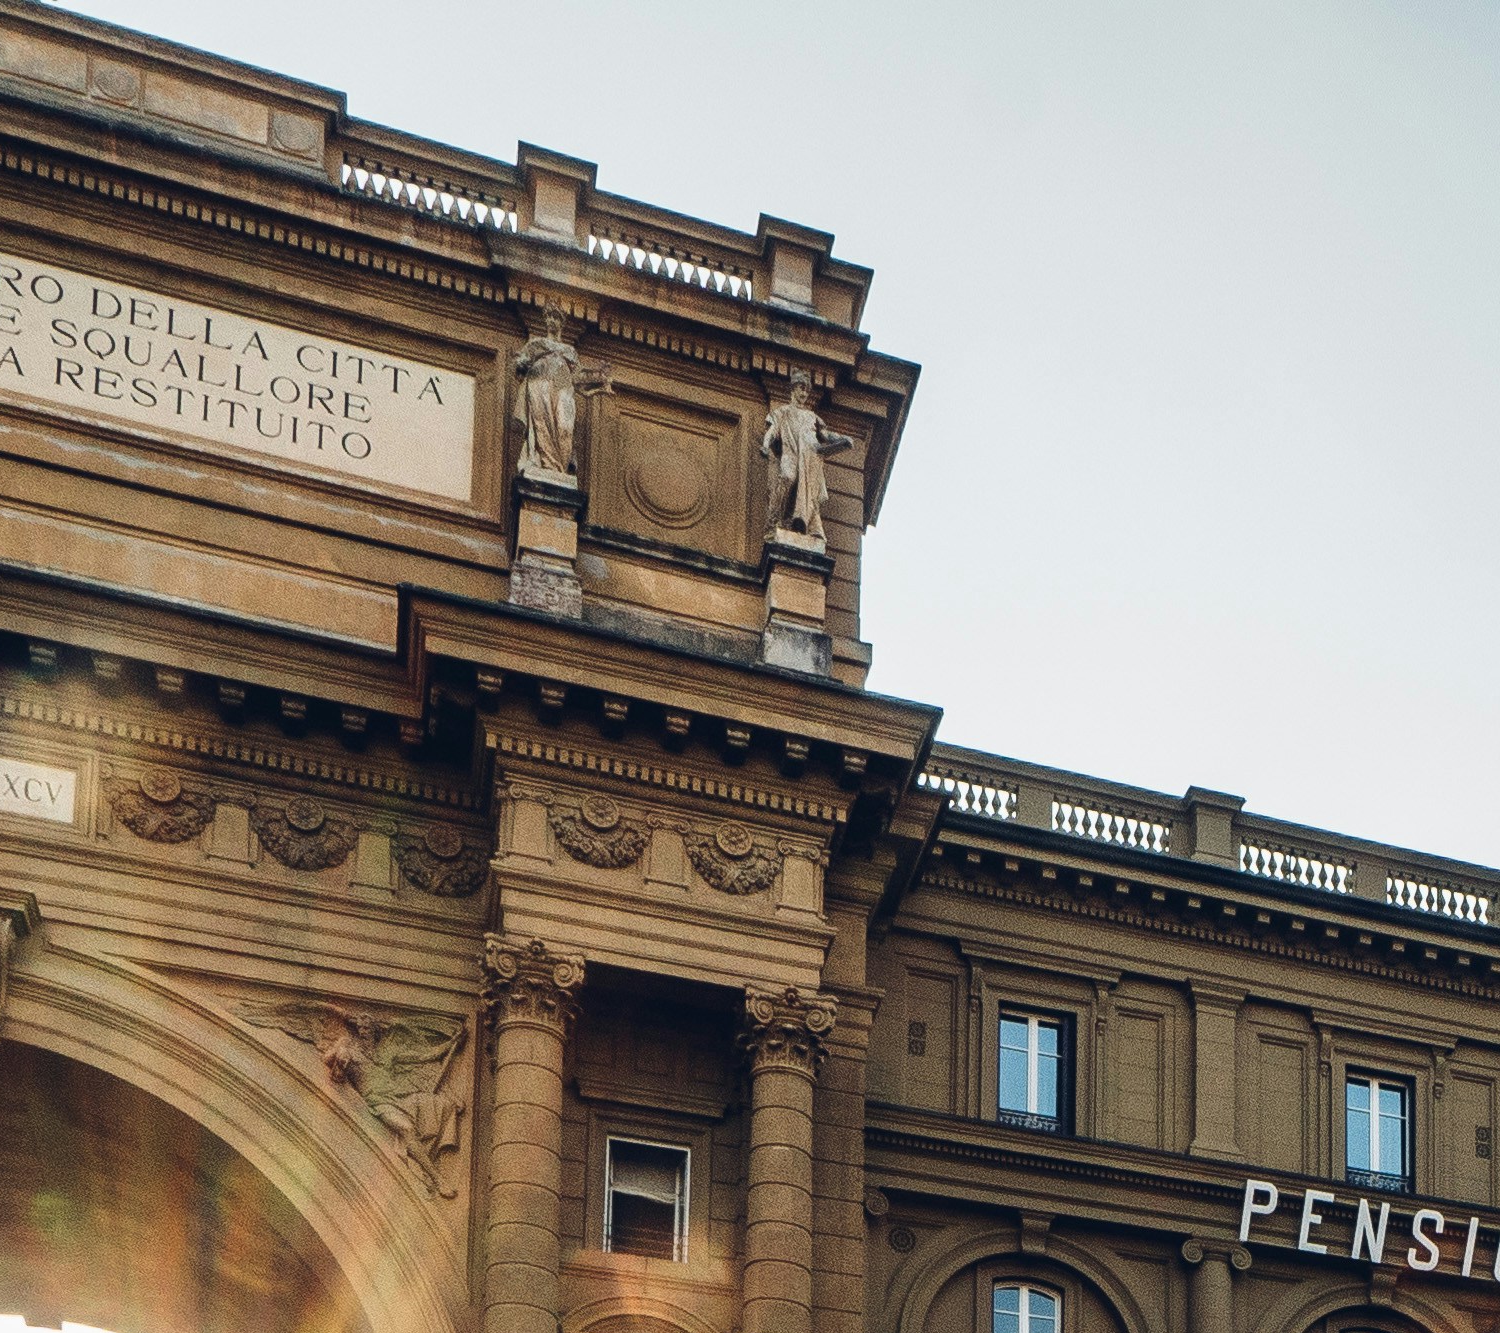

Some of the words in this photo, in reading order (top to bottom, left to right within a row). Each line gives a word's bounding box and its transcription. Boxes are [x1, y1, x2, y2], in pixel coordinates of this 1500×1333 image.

[49, 317, 373, 424] SQUALLORE
[90, 288, 270, 361] DELLA
[54, 356, 373, 460] RESTITUITO
